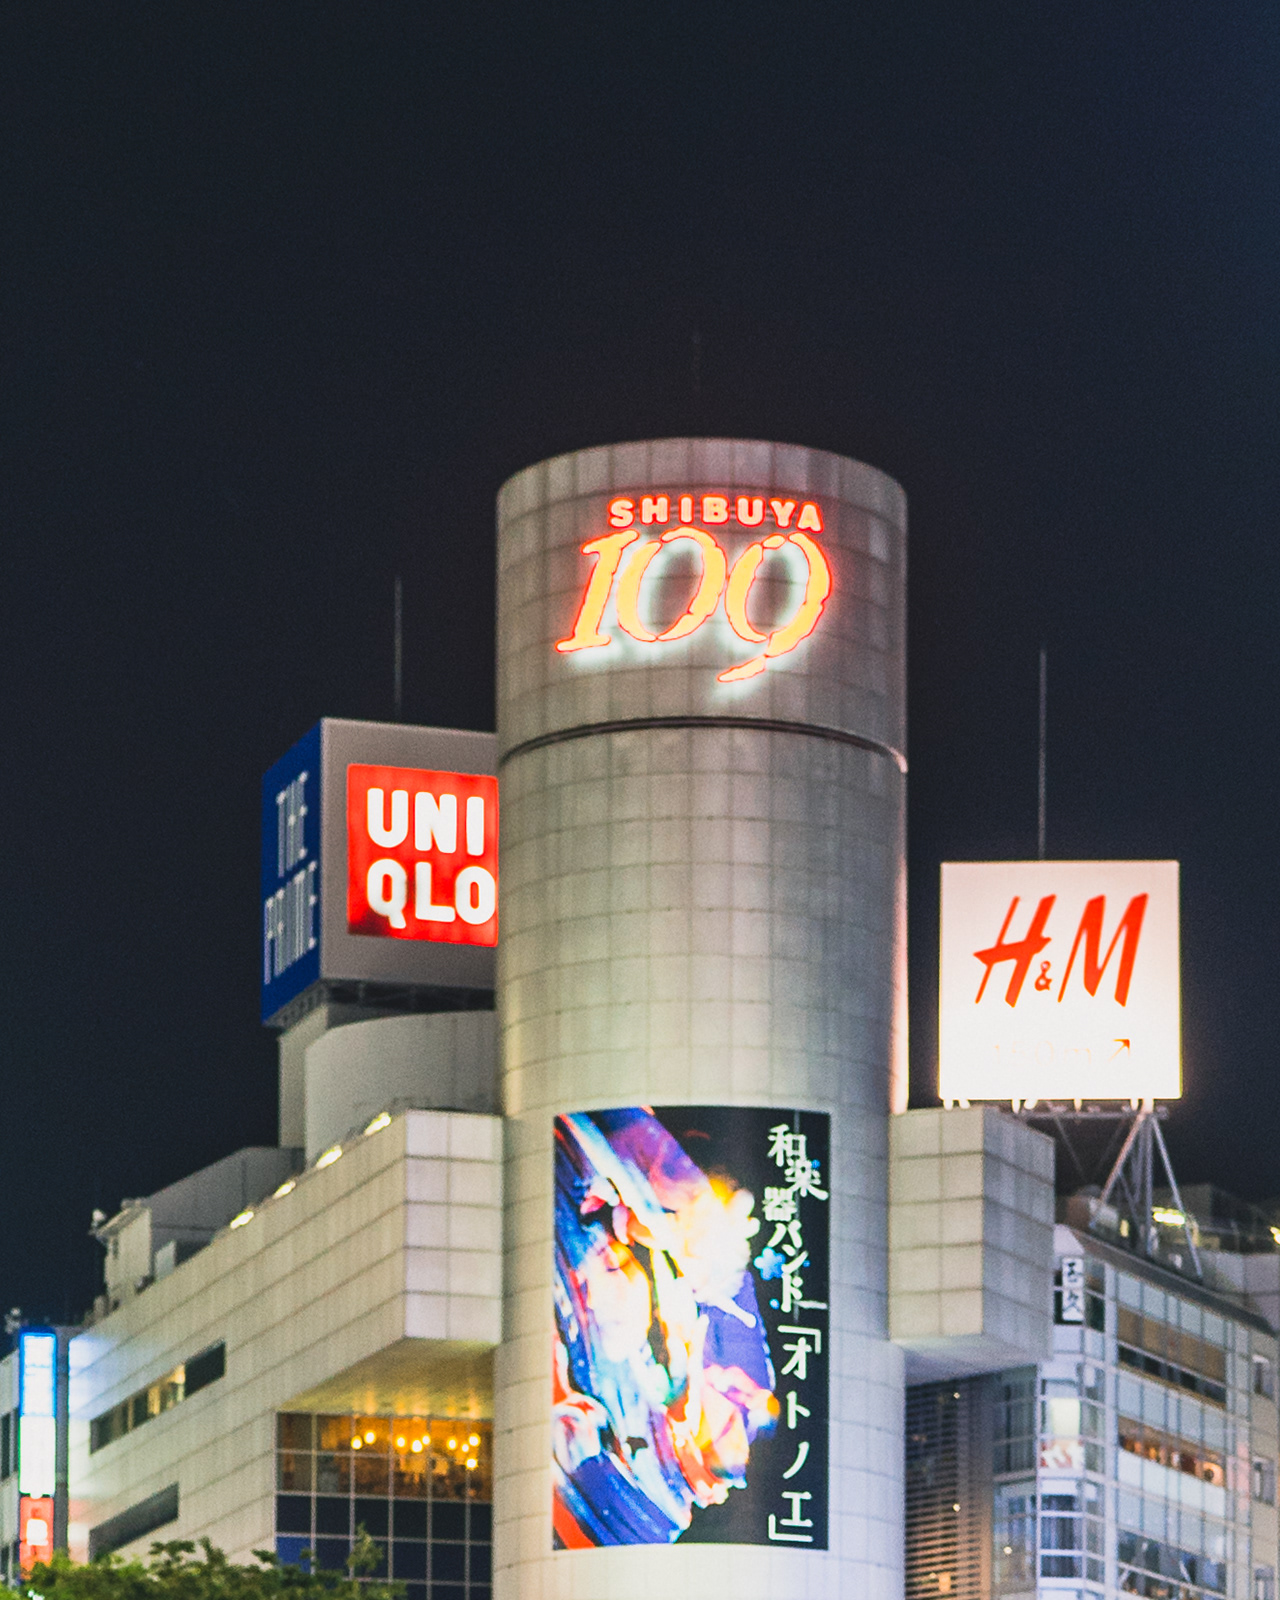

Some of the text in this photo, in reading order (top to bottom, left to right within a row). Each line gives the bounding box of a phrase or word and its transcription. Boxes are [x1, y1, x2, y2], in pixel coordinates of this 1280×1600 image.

[609, 495, 824, 532] SHIBUYA
[555, 526, 833, 683] 109
[366, 788, 486, 856] UNI
[366, 860, 497, 930] QLO
[973, 892, 1149, 1008] H&M
